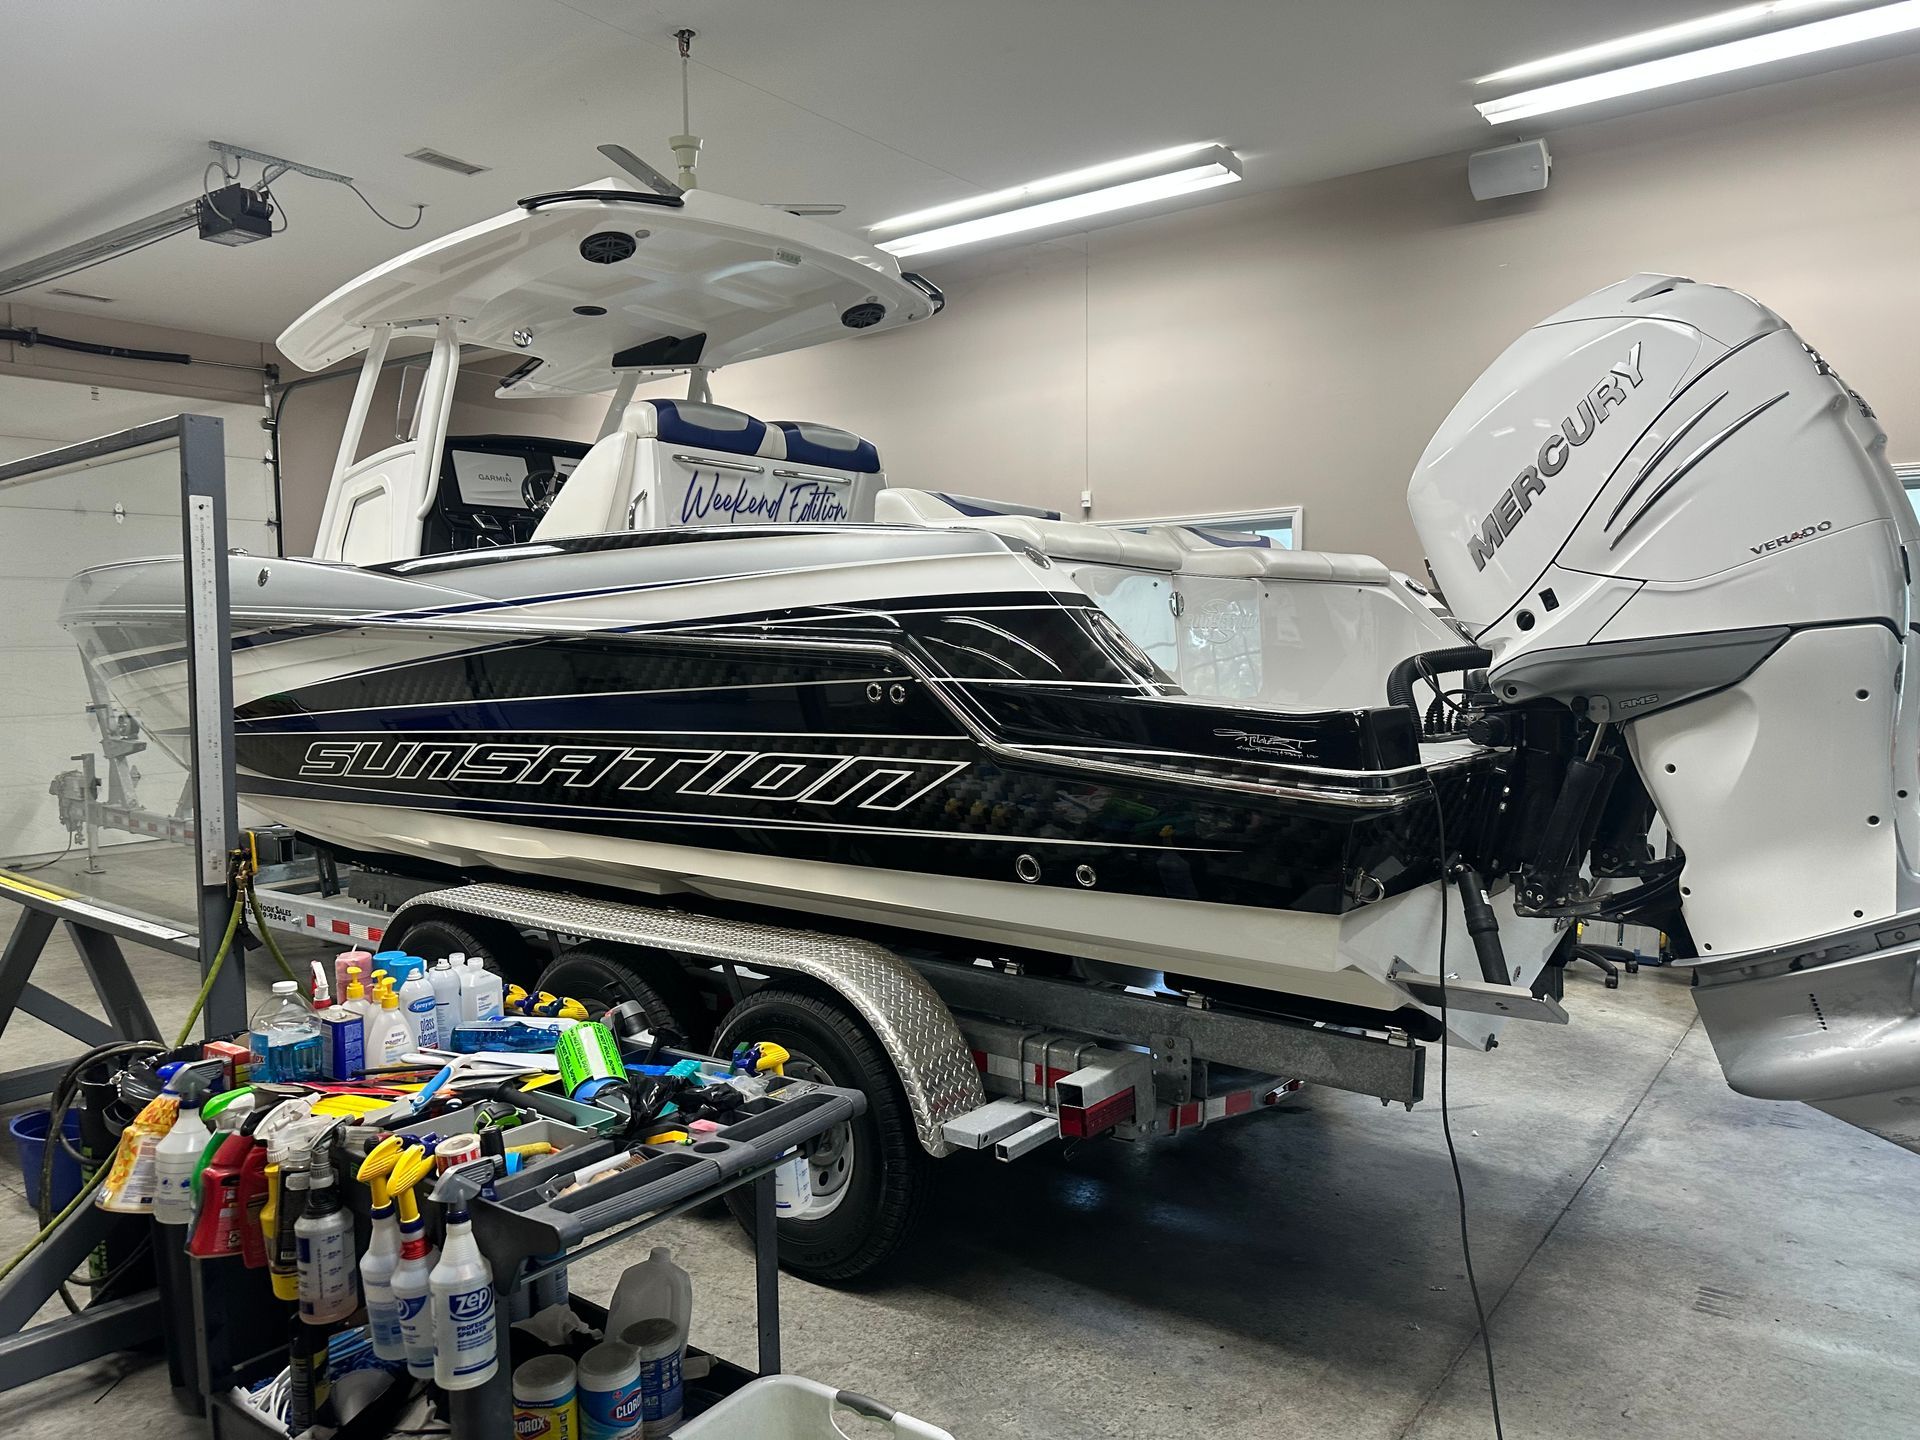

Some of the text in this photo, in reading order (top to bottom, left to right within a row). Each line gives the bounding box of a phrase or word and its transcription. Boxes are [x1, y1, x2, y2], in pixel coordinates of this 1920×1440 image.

[1467, 341, 1643, 572] MERCURY
[478, 473, 512, 483] GARMIN
[681, 470, 848, 524] Weekend Edition
[1749, 520, 1833, 555] VERADO
[299, 741, 973, 812] SUNSATION
[275, 905, 291, 917] SALES
[457, 1325, 487, 1338] SPRAYER
[616, 1391, 642, 1419] CLORO
